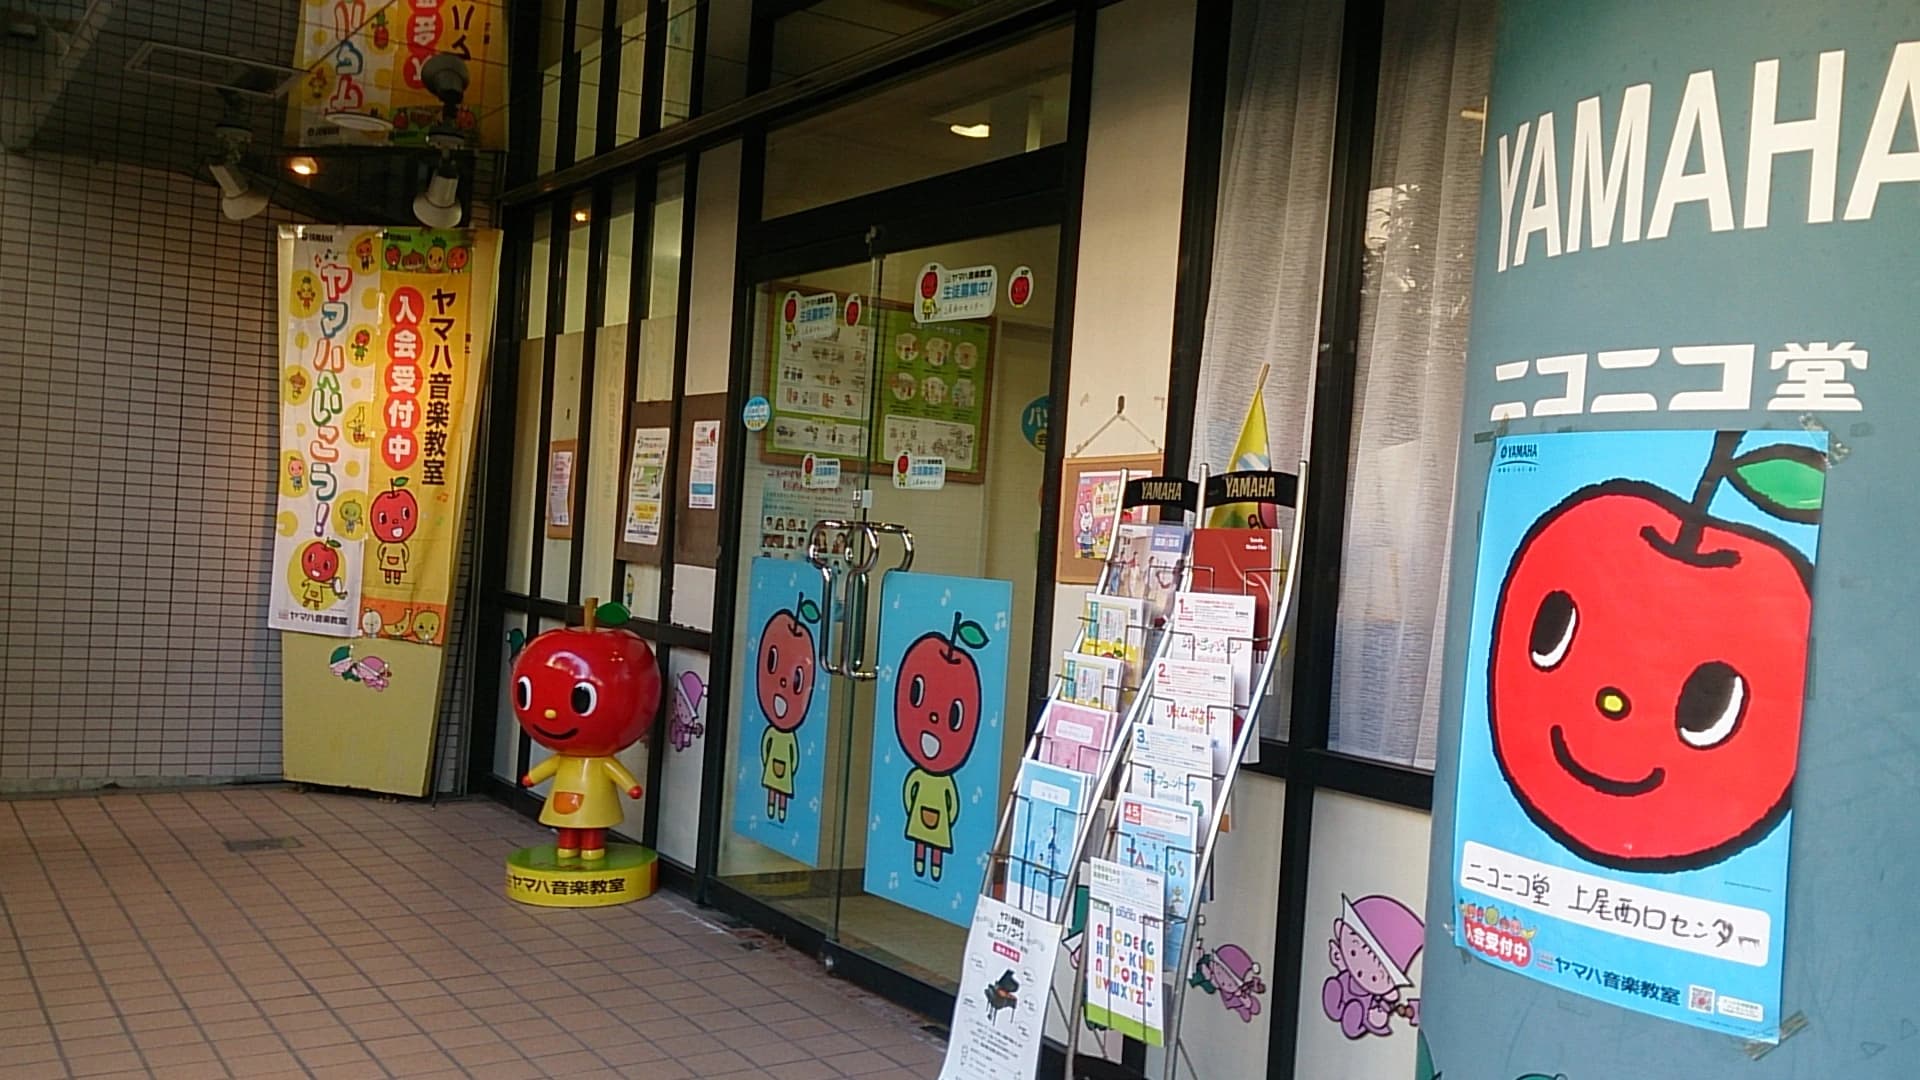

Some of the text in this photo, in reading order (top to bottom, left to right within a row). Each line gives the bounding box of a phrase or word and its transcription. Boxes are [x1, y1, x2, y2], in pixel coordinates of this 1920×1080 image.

[1498, 40, 1920, 272] YAMAHA
[308, 233, 334, 243] YAMAHA
[309, 263, 353, 537] ヤマハへいこう!
[388, 295, 418, 463] 入会受付中
[421, 288, 457, 486] ヤマハ音楽教室
[1490, 341, 1869, 421] ニコニコ堂
[1508, 444, 1537, 458] YAMAHA
[1141, 481, 1182, 501] YAMAHA
[1225, 477, 1276, 498] YAMAHA
[512, 875, 626, 896] ヤマハ音楽教室
[1465, 864, 1761, 950] ニコニコ堂 上尾西口センター
[1466, 923, 1528, 960] 入会受付中
[1553, 956, 1682, 1008] ヤマハ音楽教室
